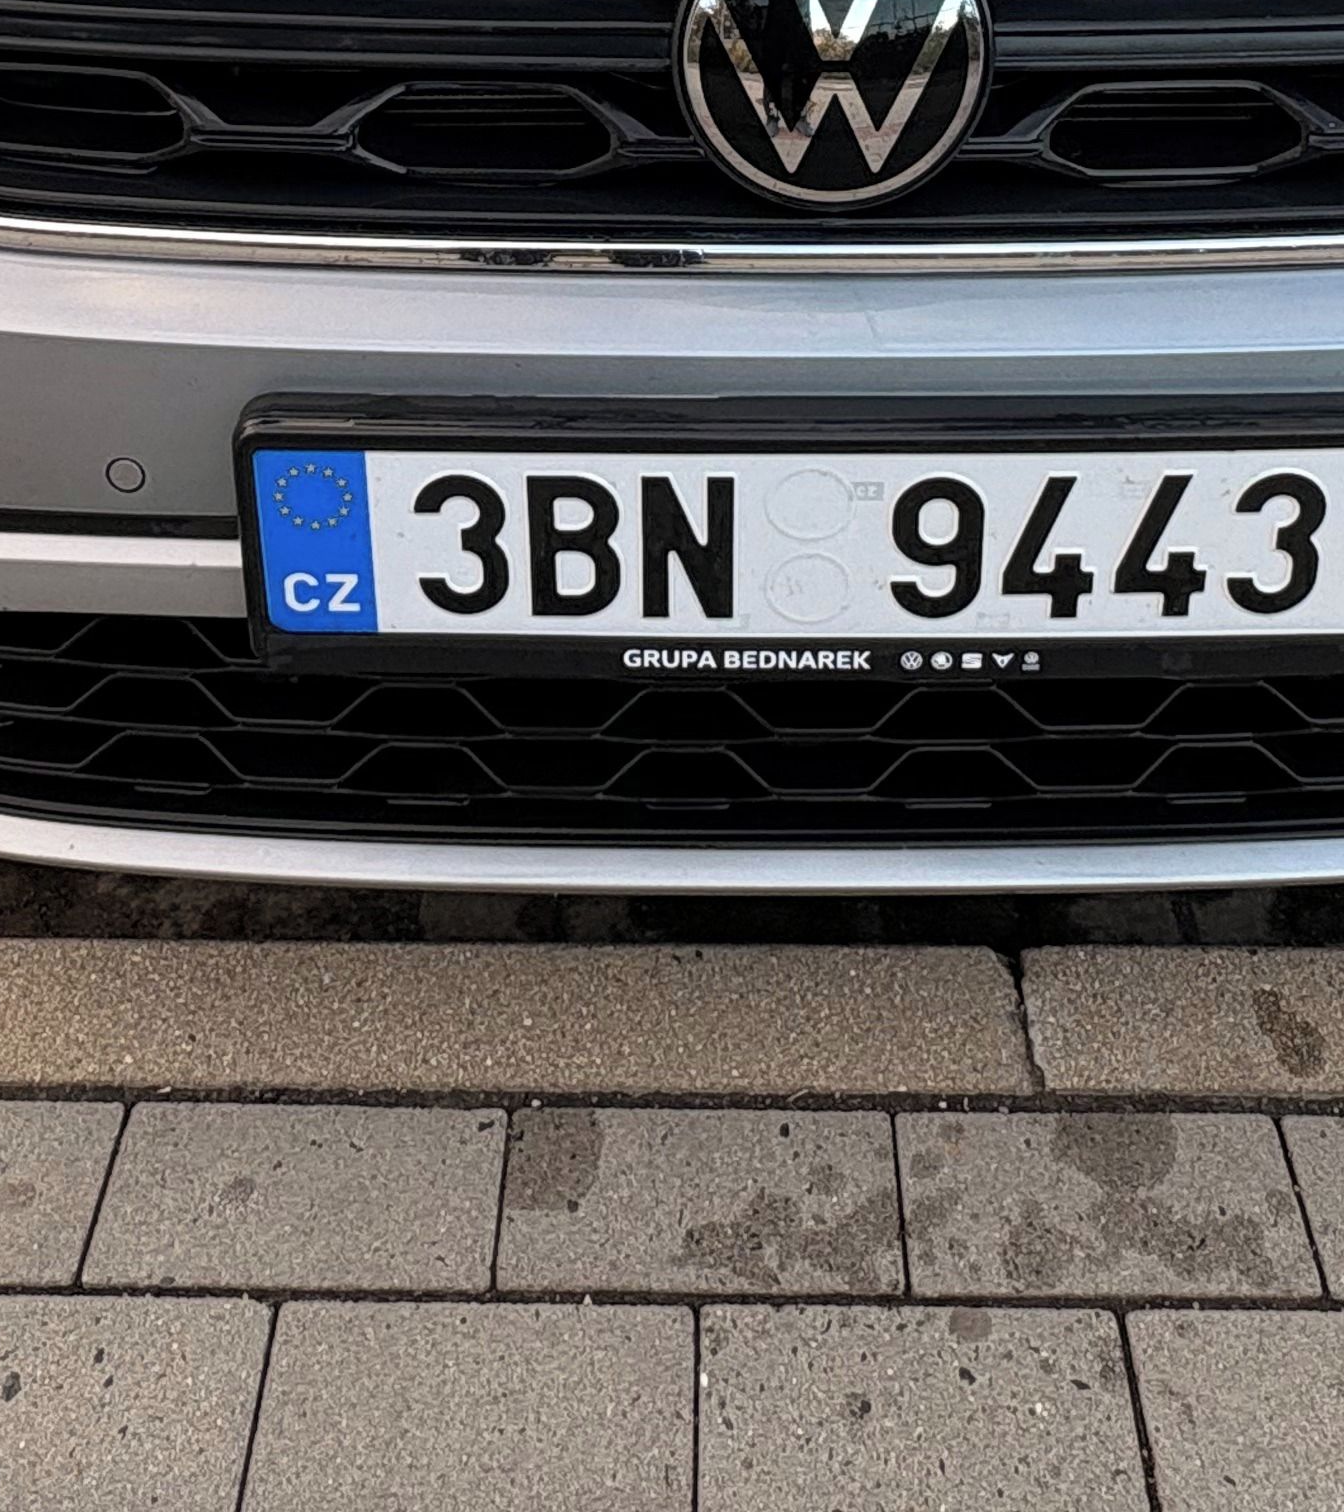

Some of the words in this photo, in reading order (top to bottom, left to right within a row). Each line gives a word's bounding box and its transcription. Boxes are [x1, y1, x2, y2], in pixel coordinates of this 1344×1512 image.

[283, 572, 361, 612] CZ
[413, 473, 735, 618] 3BN
[889, 471, 1327, 619] 9443
[623, 649, 717, 669] GRUPA
[723, 650, 872, 671] BEDNAREK
